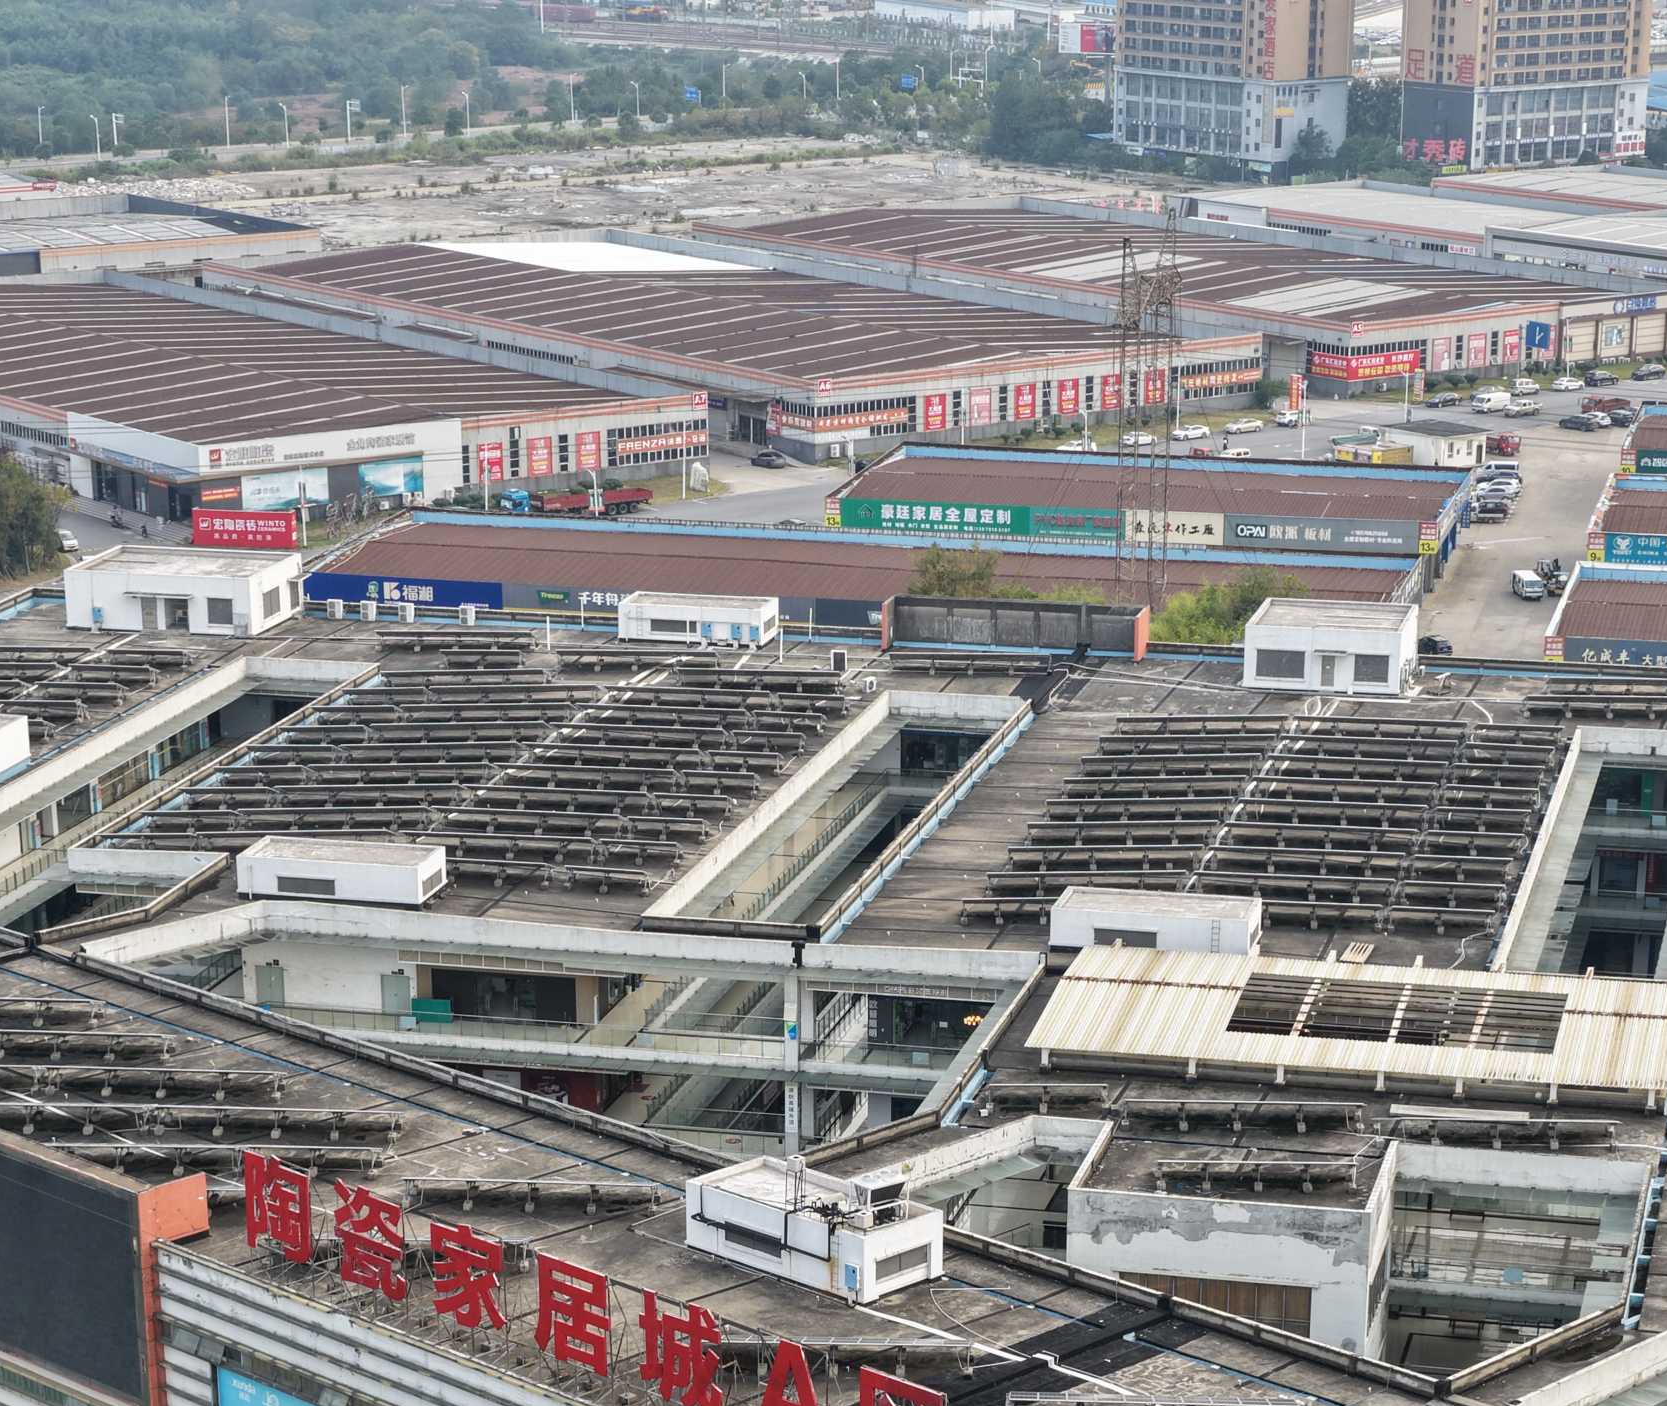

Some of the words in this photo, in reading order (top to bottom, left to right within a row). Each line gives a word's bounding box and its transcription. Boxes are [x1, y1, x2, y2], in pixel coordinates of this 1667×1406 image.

[618, 438, 666, 452] FAENZA
[881, 504, 1011, 525] 豪廷家居全屋定制
[213, 518, 257, 532] 宏陶瓷砖
[1237, 526, 1265, 536] OPAI
[402, 584, 434, 602] 福湘
